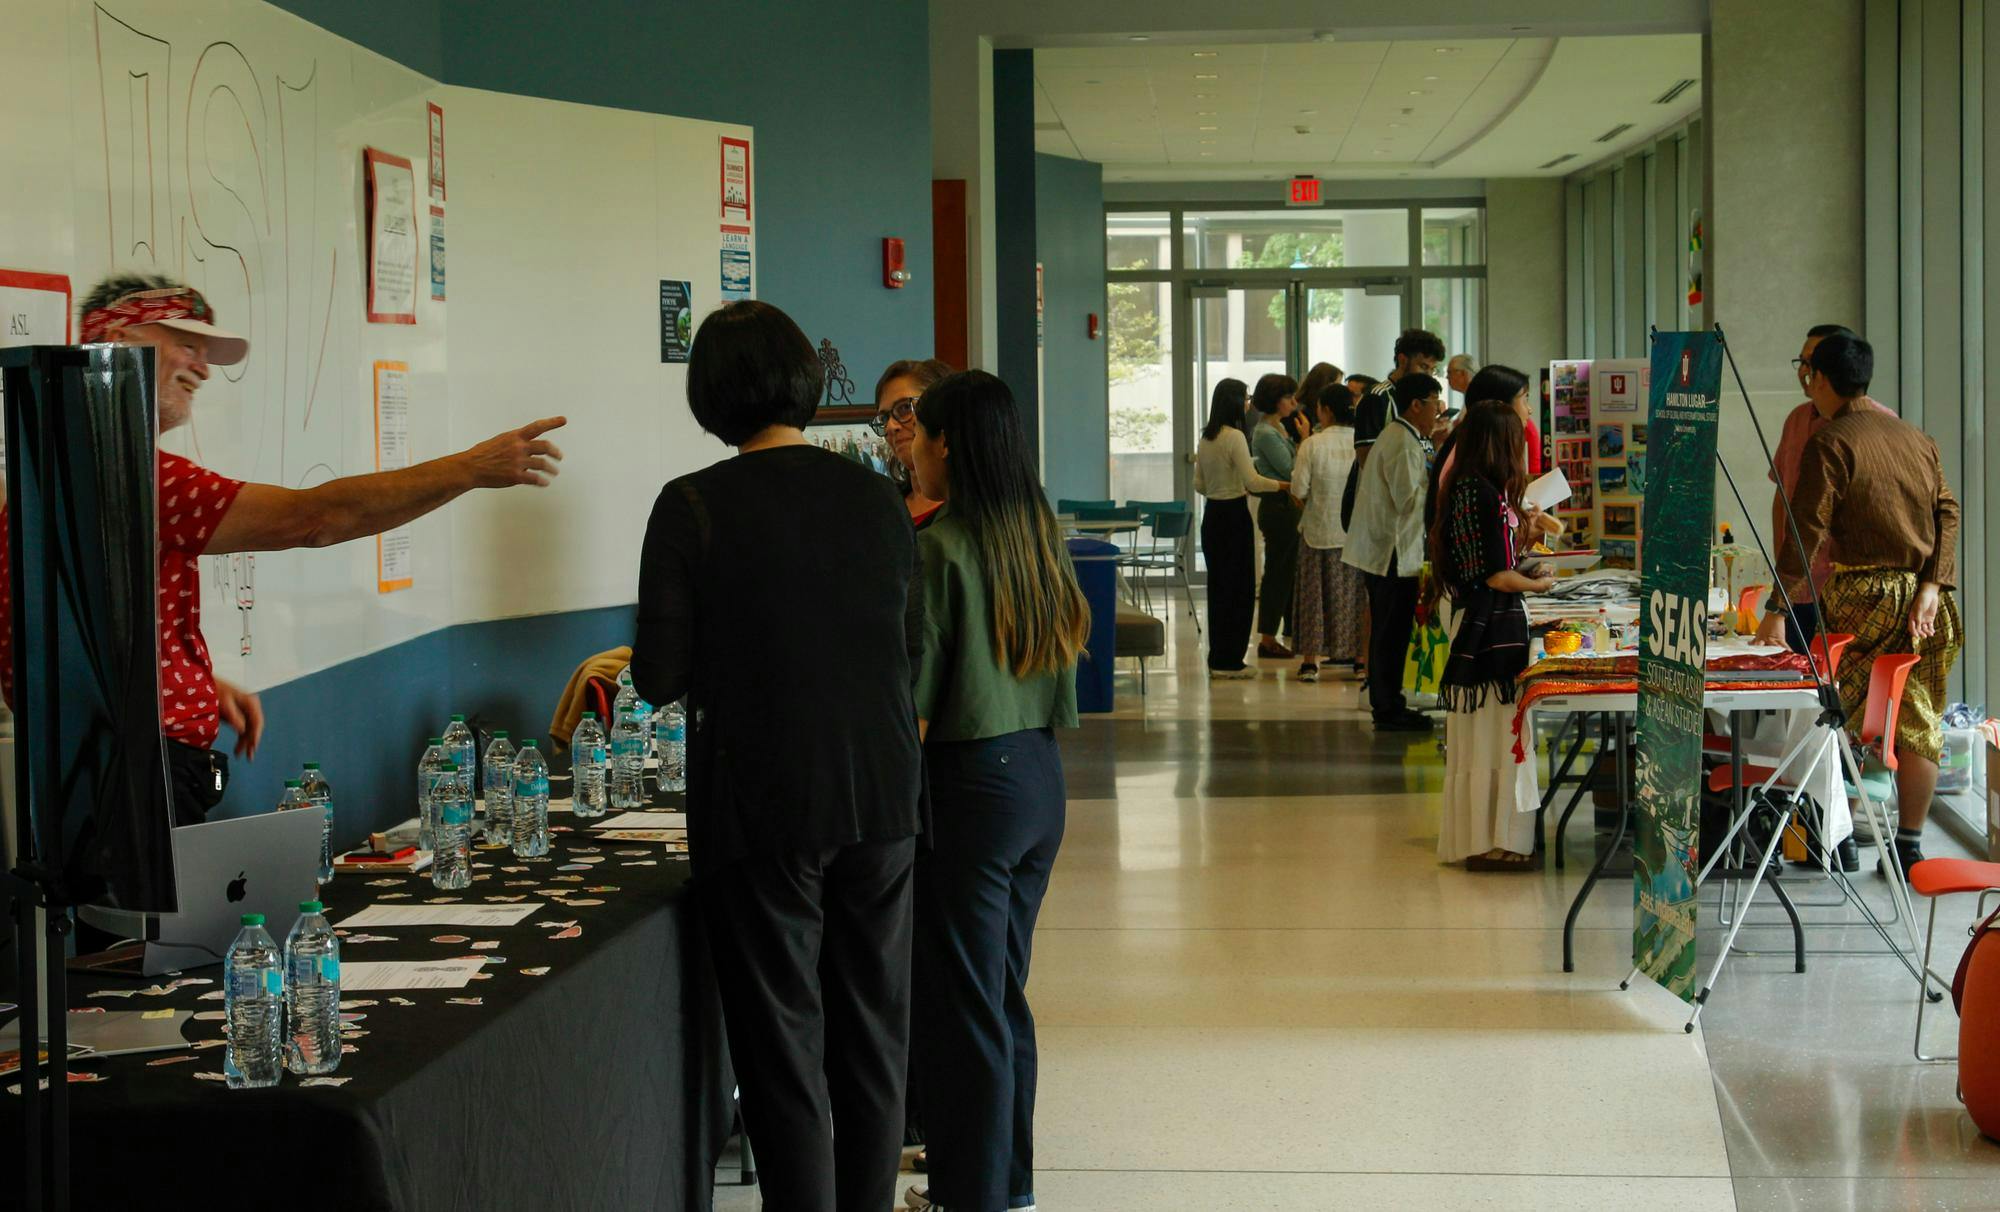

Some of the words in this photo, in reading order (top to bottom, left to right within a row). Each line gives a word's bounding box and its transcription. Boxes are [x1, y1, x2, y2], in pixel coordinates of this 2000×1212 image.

[1292, 180, 1319, 202] EXIT
[722, 233, 742, 243] LEARN
[722, 242, 748, 250] LANGUAGE
[10, 313, 30, 335] ASL
[1666, 392, 1687, 407] HAMILTON
[1688, 394, 1706, 409] LUGAR
[1649, 589, 1706, 669] SEAS
[1647, 662, 1687, 696] SOUTHEAST
[1645, 694, 1652, 717] &
[1652, 697, 1674, 726] ASEAN
